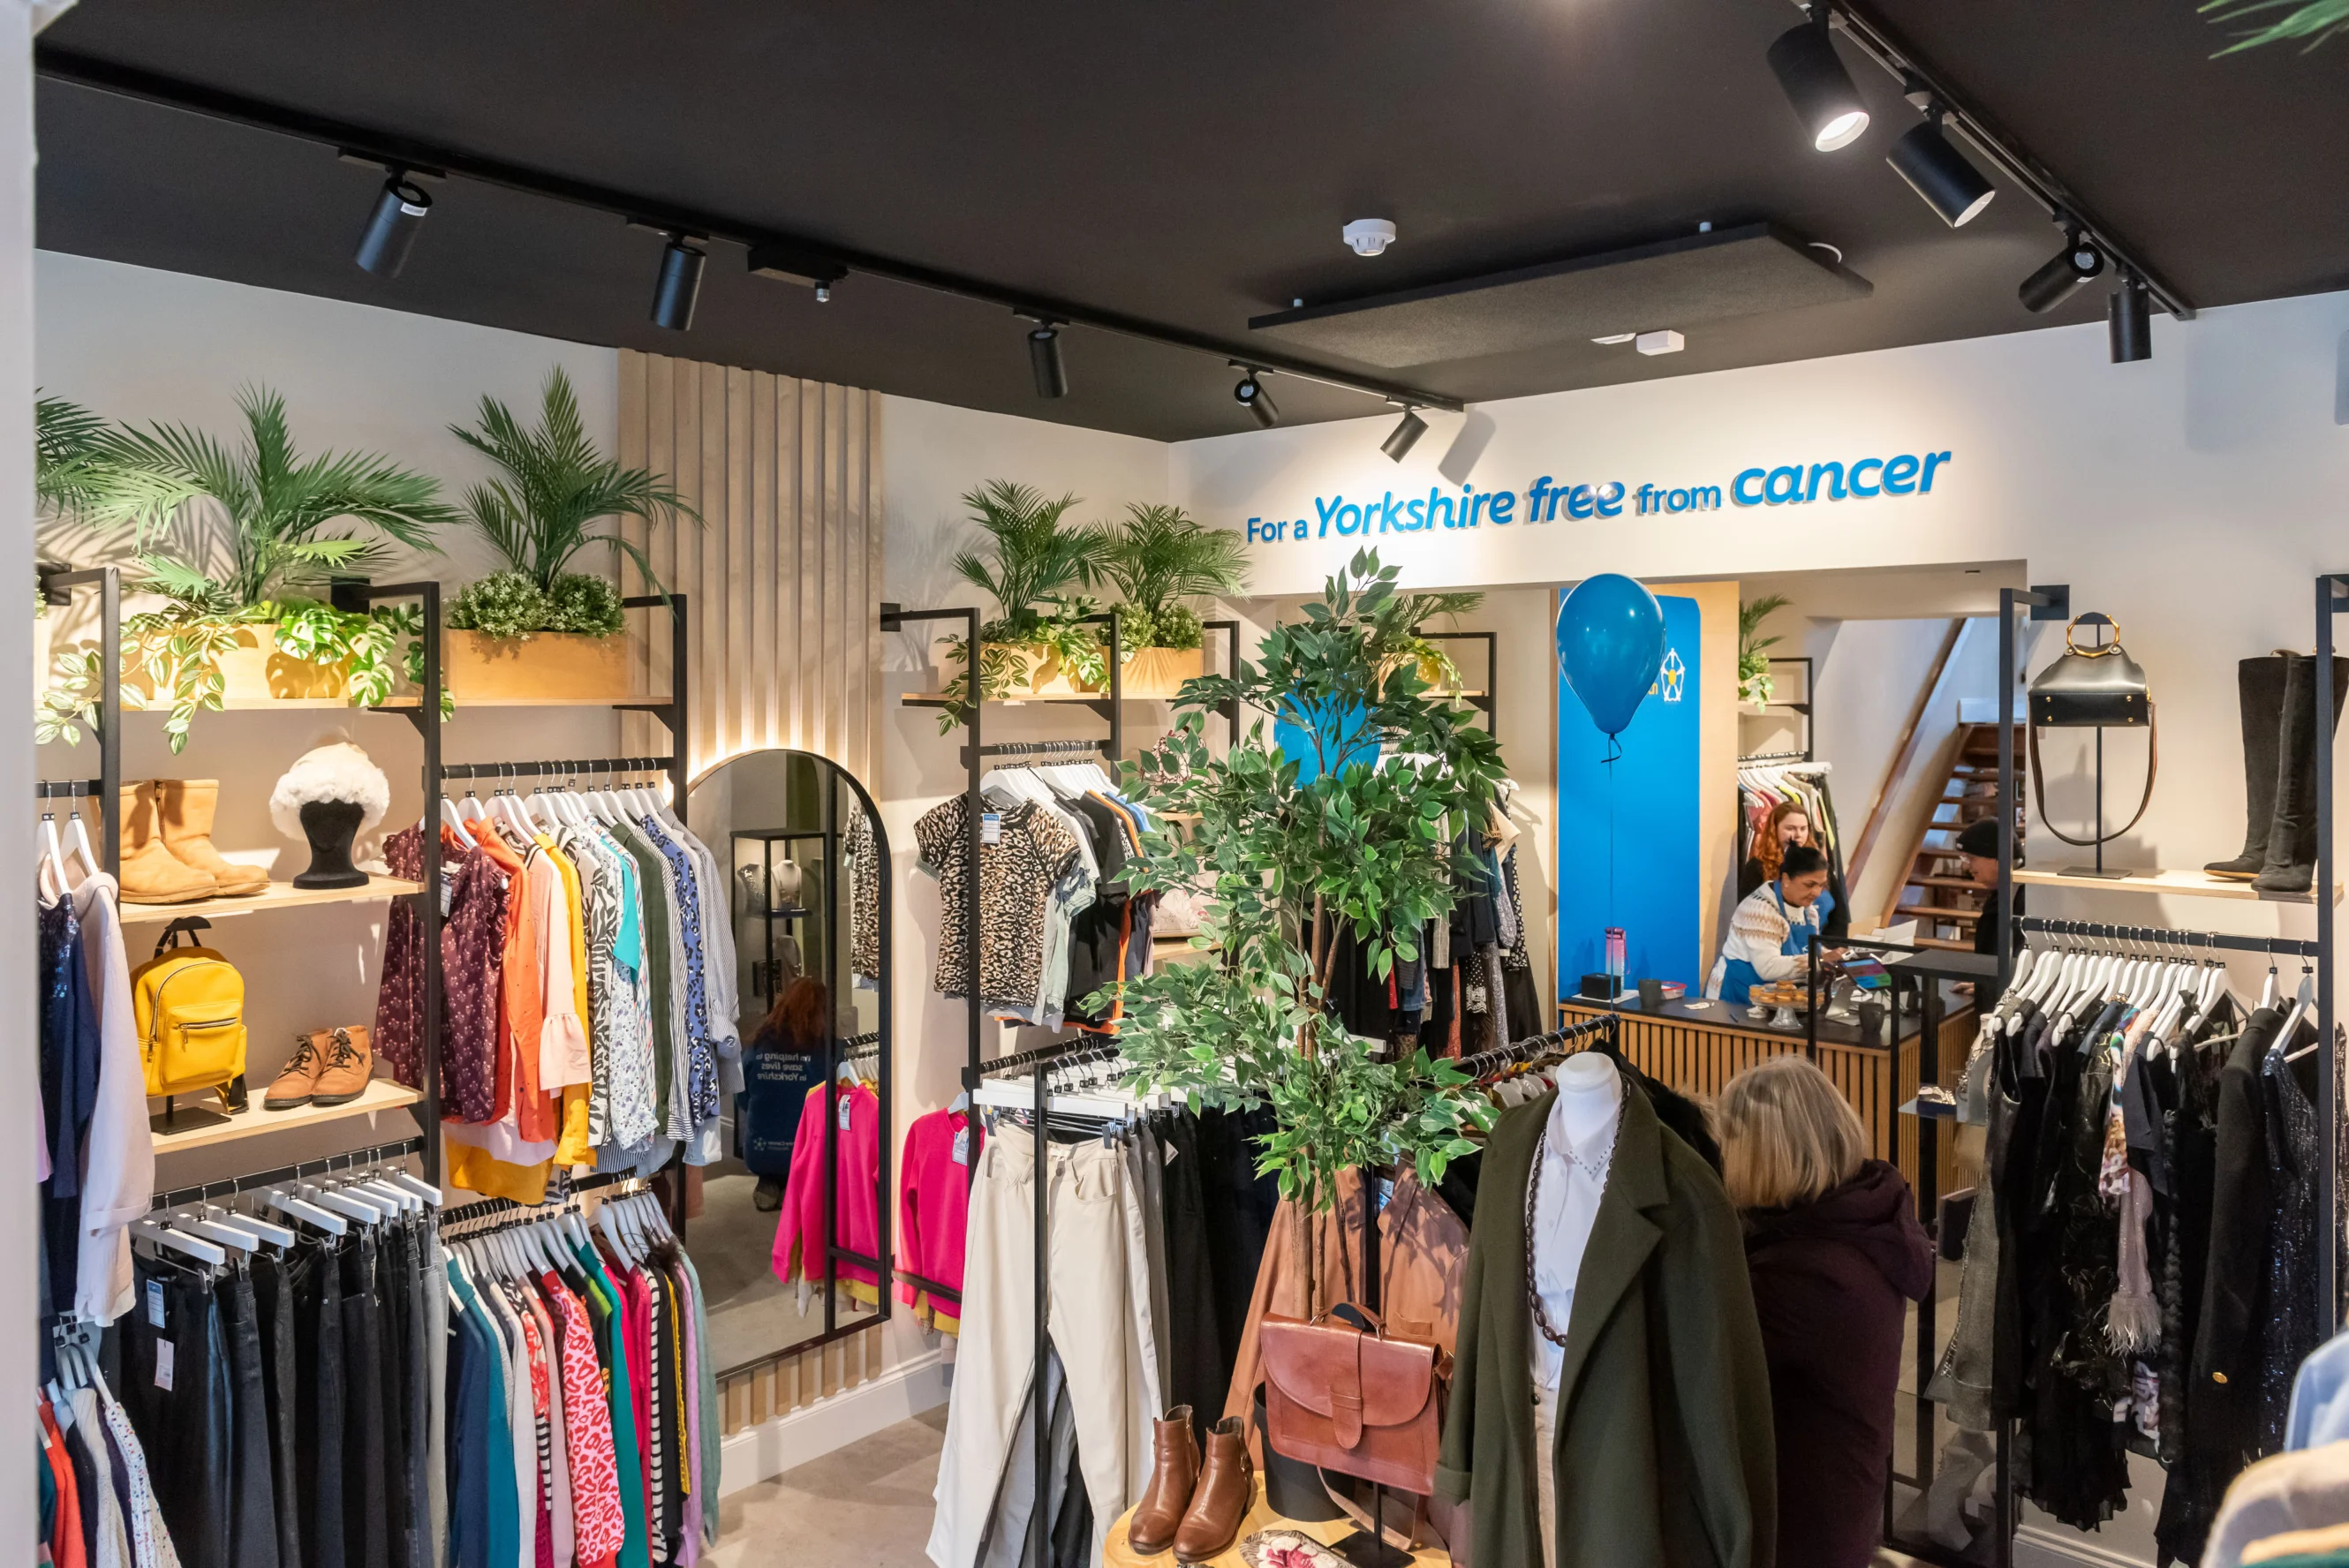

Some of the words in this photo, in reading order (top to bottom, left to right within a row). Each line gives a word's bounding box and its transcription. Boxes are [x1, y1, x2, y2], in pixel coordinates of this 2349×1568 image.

[1247, 516, 1288, 543] For
[1293, 518, 1309, 540] a
[1314, 484, 1516, 538] Yorkshire
[1529, 476, 1626, 523] free
[1637, 483, 1722, 514] from
[1733, 450, 1952, 506] cancer
